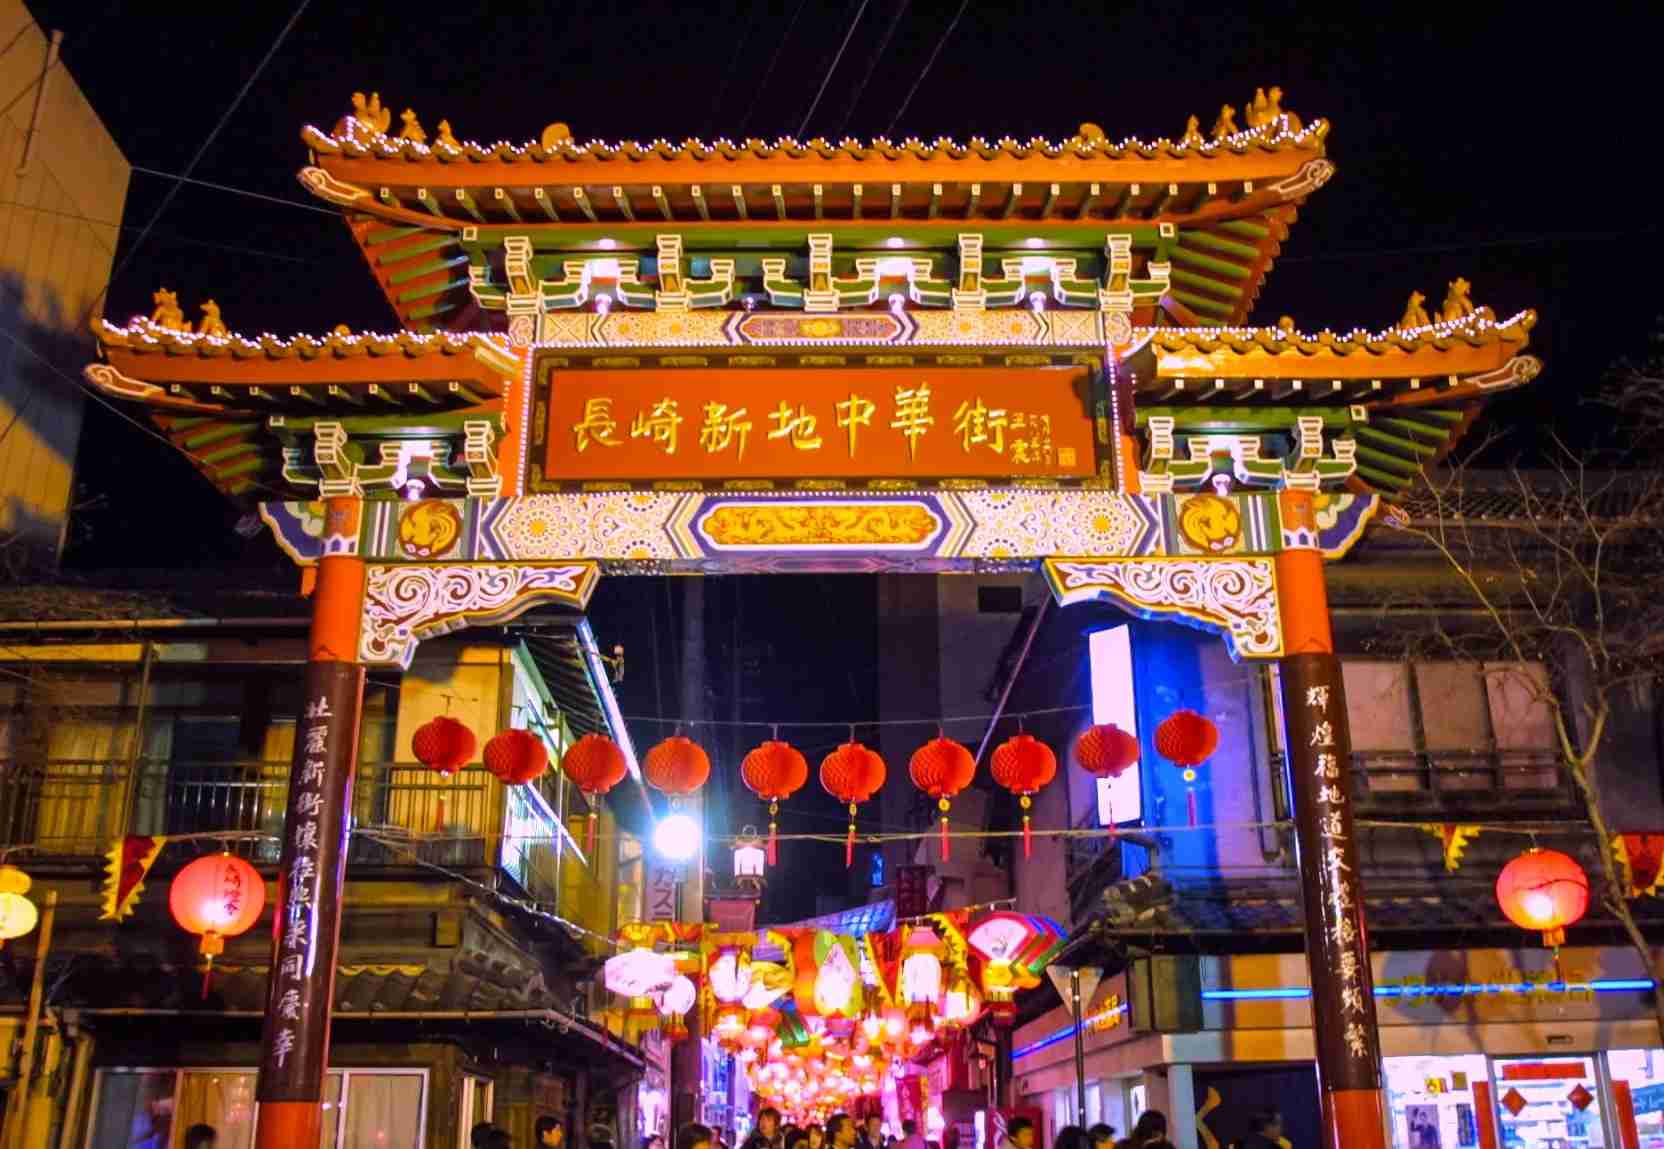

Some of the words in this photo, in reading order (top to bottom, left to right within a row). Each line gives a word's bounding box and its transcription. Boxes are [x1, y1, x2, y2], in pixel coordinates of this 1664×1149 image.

[573, 382, 1008, 462] 長崎新地中華街
